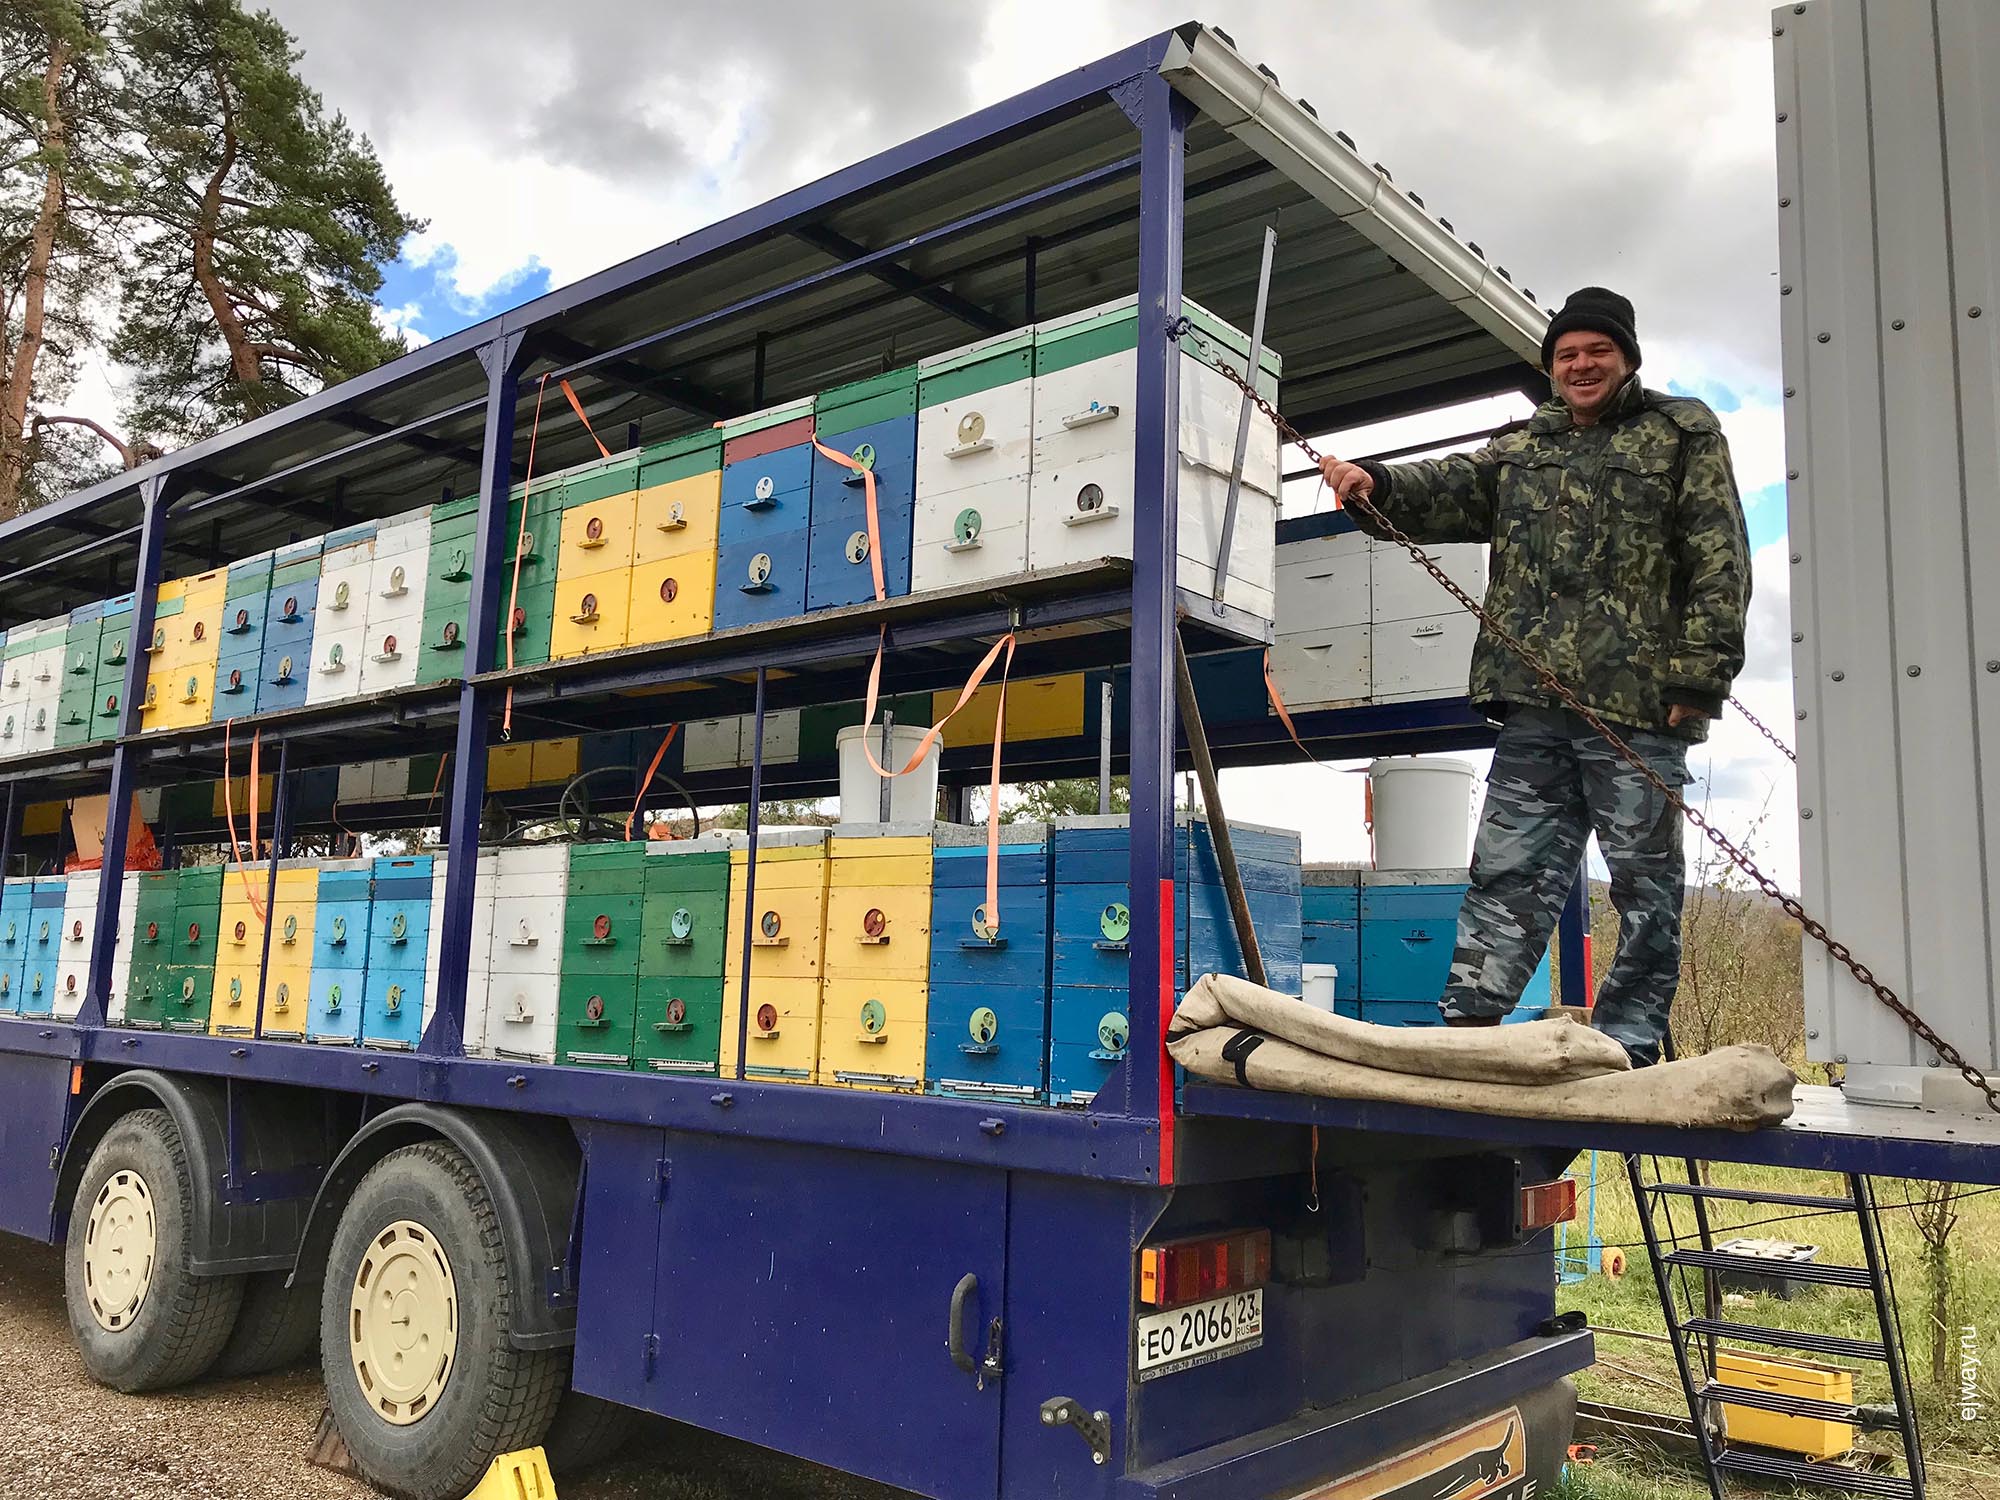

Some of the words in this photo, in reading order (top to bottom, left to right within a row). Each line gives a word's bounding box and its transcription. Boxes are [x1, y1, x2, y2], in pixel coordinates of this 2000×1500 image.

[1180, 1302, 1232, 1352] 2066
[1237, 1293, 1256, 1325] 23
[1237, 1325, 1250, 1337] RUS
